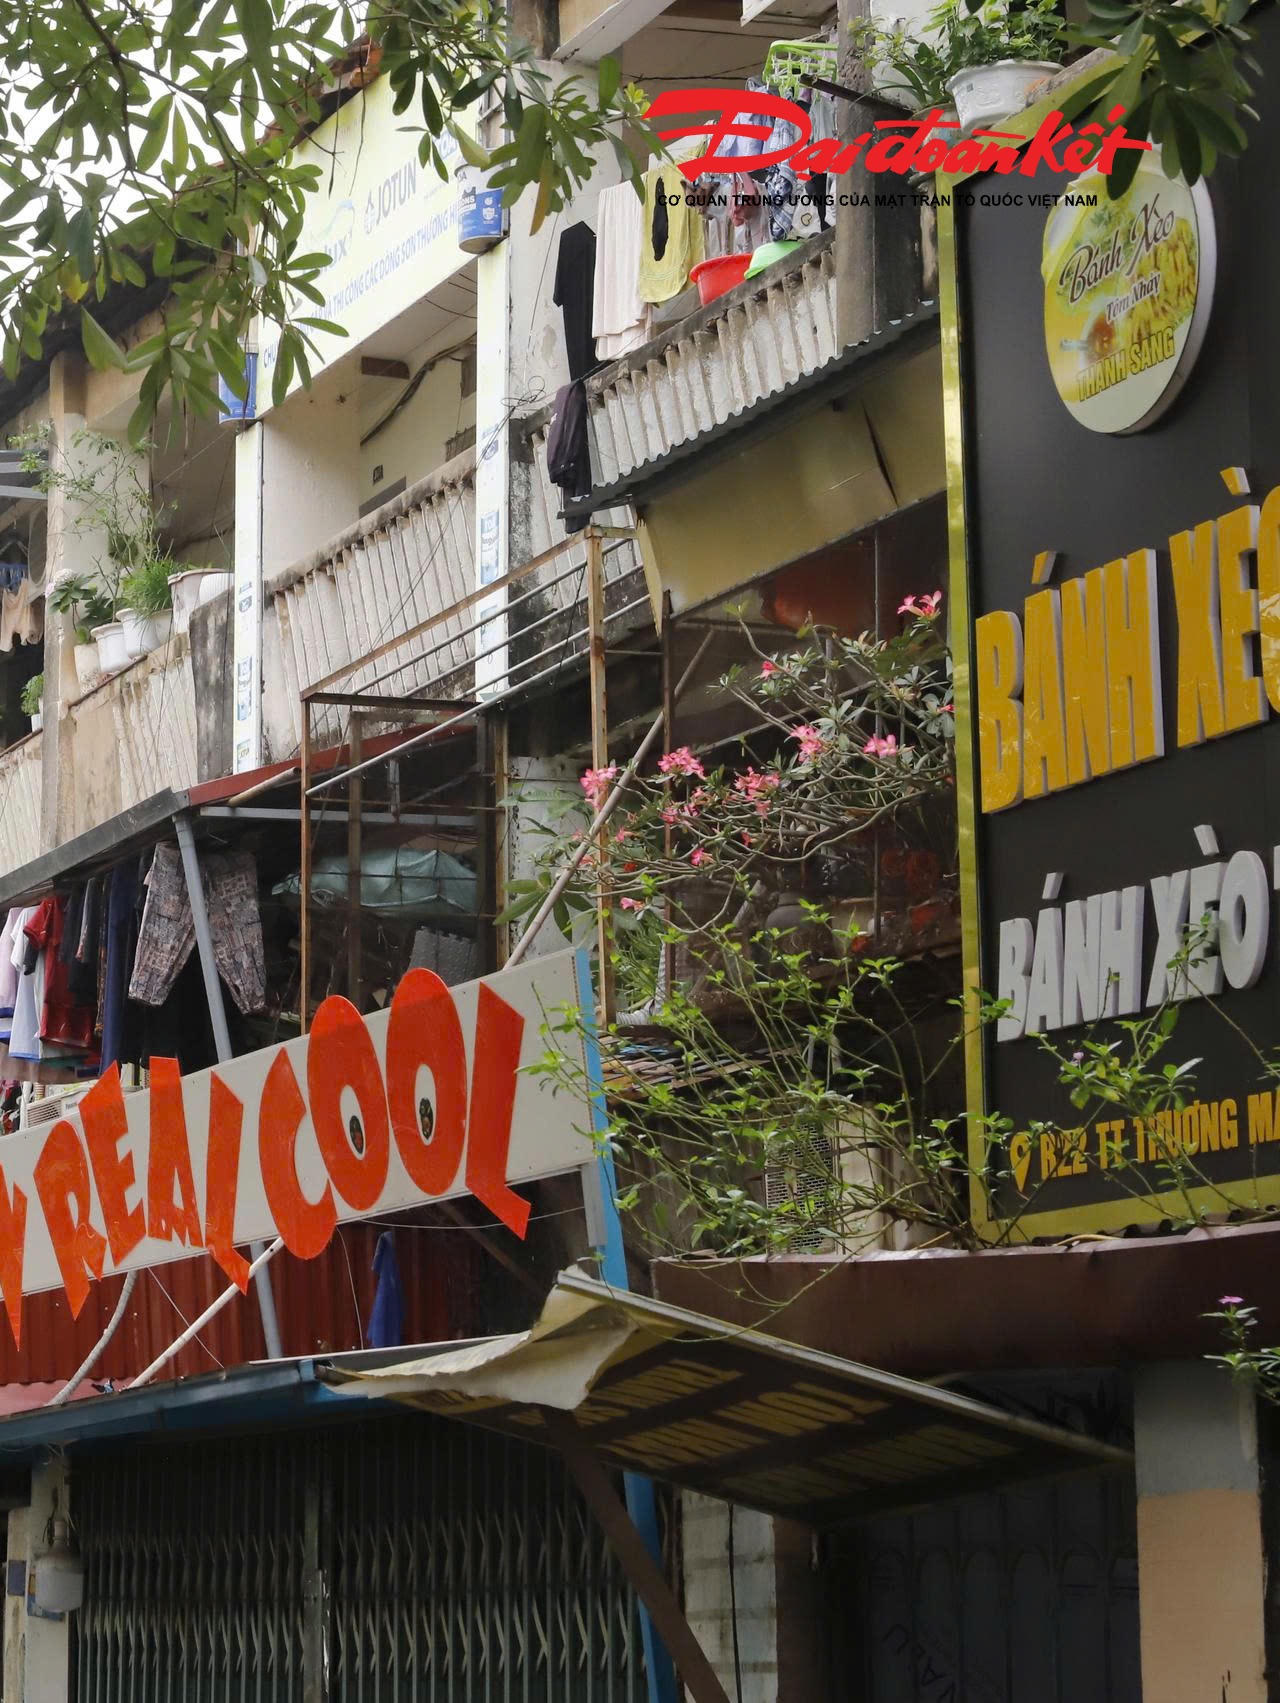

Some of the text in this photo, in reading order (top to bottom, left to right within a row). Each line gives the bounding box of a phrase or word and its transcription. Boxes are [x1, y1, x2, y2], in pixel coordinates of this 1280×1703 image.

[375, 157, 417, 225] JOTUN
[1059, 193, 1176, 304] Bánh Xèo
[1075, 326, 1176, 403] THANH SANG
[975, 548, 1165, 814] BÁNH
[997, 824, 1269, 1043] BÁNH XÈO
[33, 1055, 251, 1321] REAL
[258, 967, 532, 1261] COOL
[1095, 1119, 1125, 1169] TT
